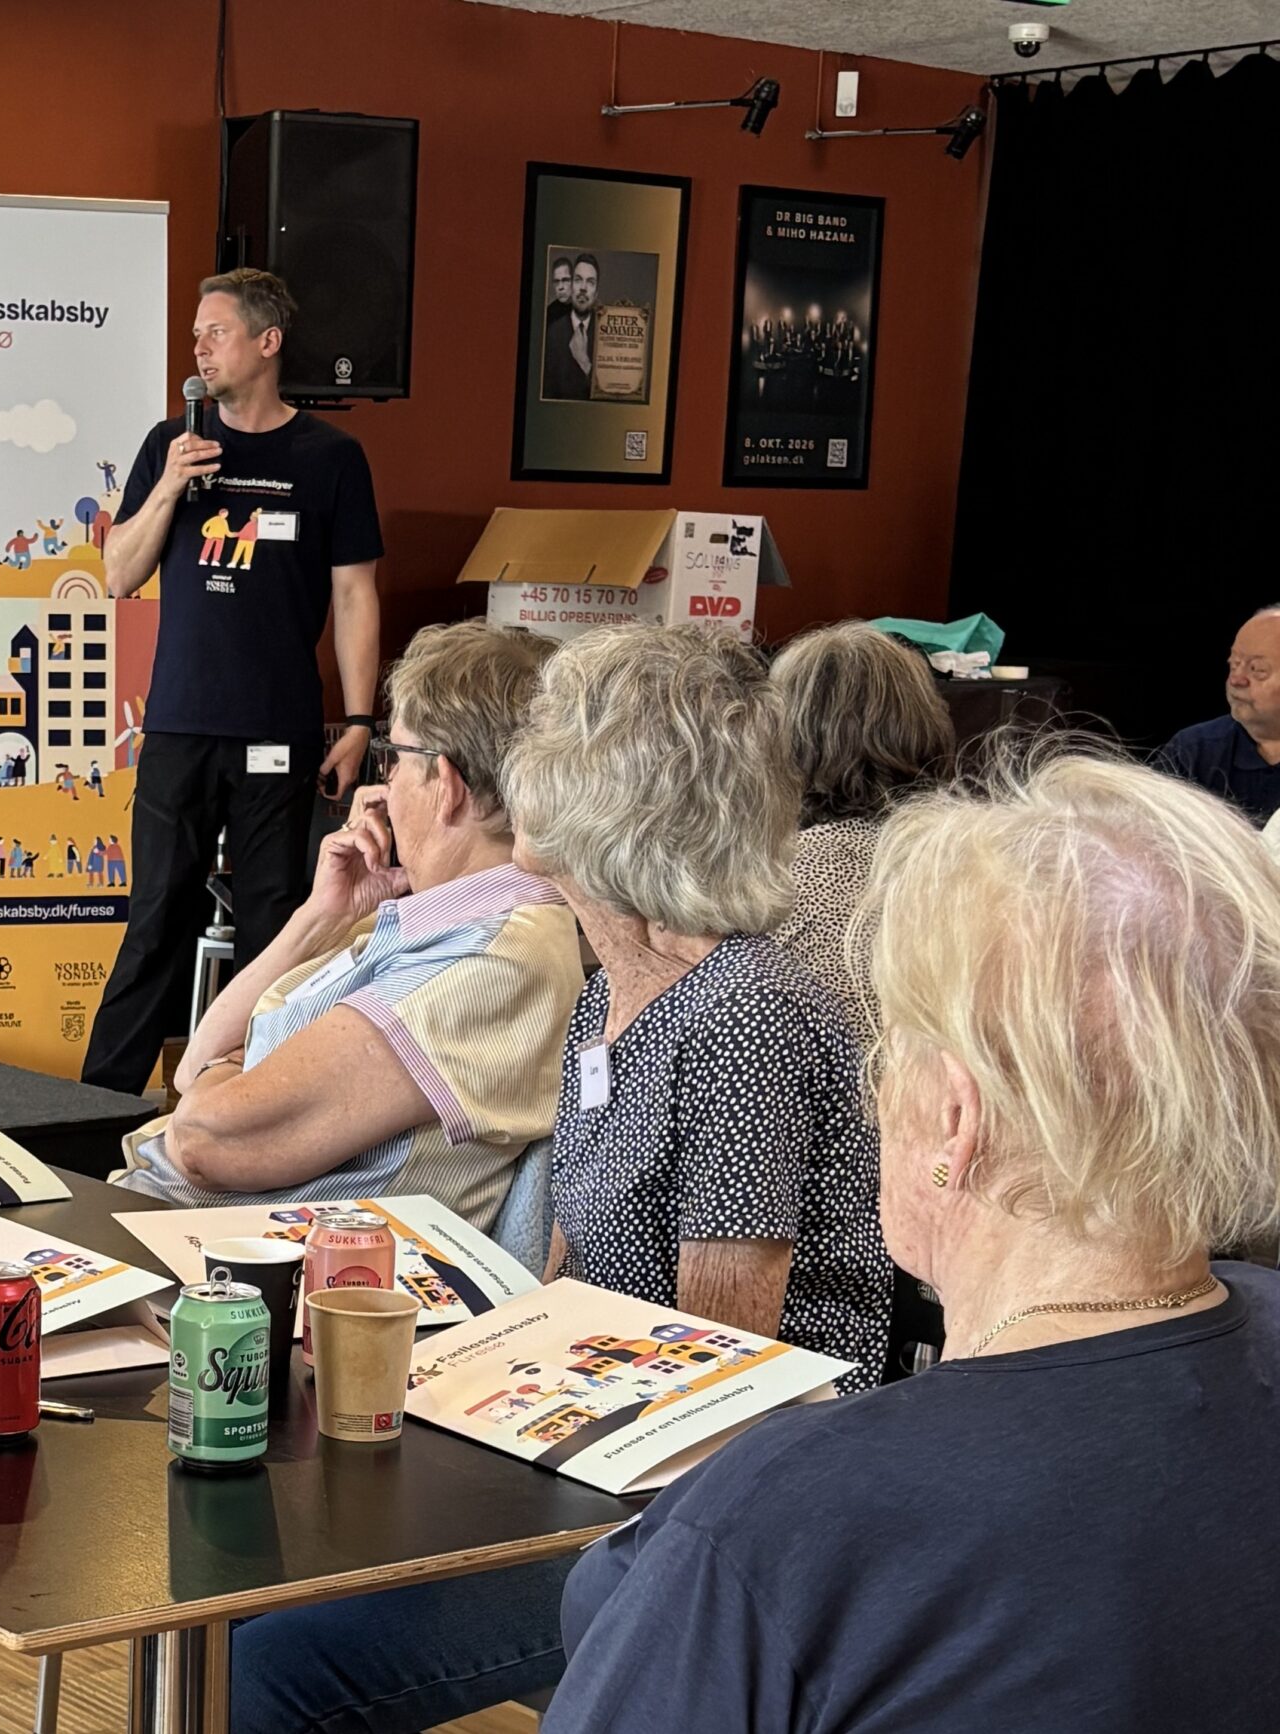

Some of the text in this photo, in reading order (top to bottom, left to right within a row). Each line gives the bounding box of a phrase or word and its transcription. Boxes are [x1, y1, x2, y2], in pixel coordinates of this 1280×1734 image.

[776, 211, 847, 227] DR BIG BAND
[777, 227, 806, 239] MIHO
[810, 230, 855, 243] HAZAMA
[607, 315, 638, 326] PETER
[600, 325, 644, 337] SOMMER
[521, 588, 638, 606] +45 70 15 70 70
[520, 609, 556, 622] BILLIG
[54, 962, 104, 972] NORDEA
[329, 1235, 384, 1245] SUKKERFRI
[436, 1312, 549, 1363] Fællesskabsby
[604, 1435, 645, 1459] Furesø
[658, 1420, 675, 1430] en
